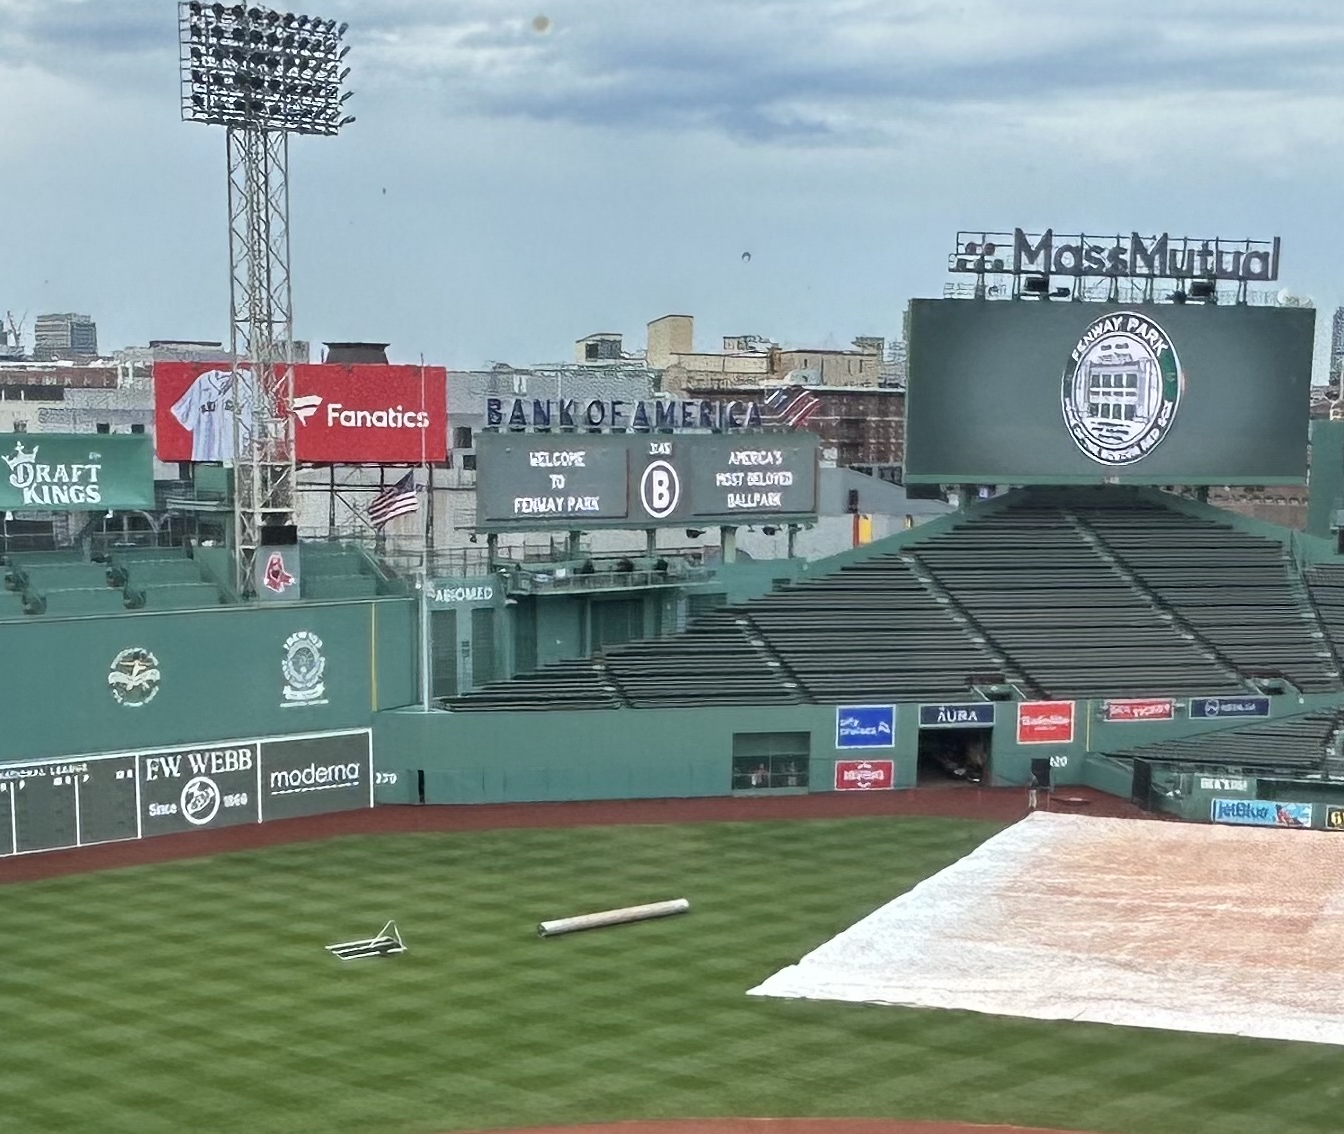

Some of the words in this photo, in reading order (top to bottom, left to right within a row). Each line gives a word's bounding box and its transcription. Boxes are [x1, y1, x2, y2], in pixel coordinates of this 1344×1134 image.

[1014, 228, 1281, 280] MassMutual
[1072, 315, 1124, 361] FENWAY
[1126, 317, 1169, 357] PARK
[326, 403, 430, 429] Fanatics
[486, 398, 576, 427] BANK
[586, 399, 626, 426] OF
[631, 398, 763, 428] AMERICA
[9, 463, 102, 488] DRAFT
[549, 474, 567, 489] TO
[23, 483, 102, 505] KINGS
[651, 469, 669, 509] B
[936, 706, 979, 723] AURA
[187, 748, 253, 775] WEBB
[270, 762, 361, 789] moderna
[148, 802, 178, 817] Since
